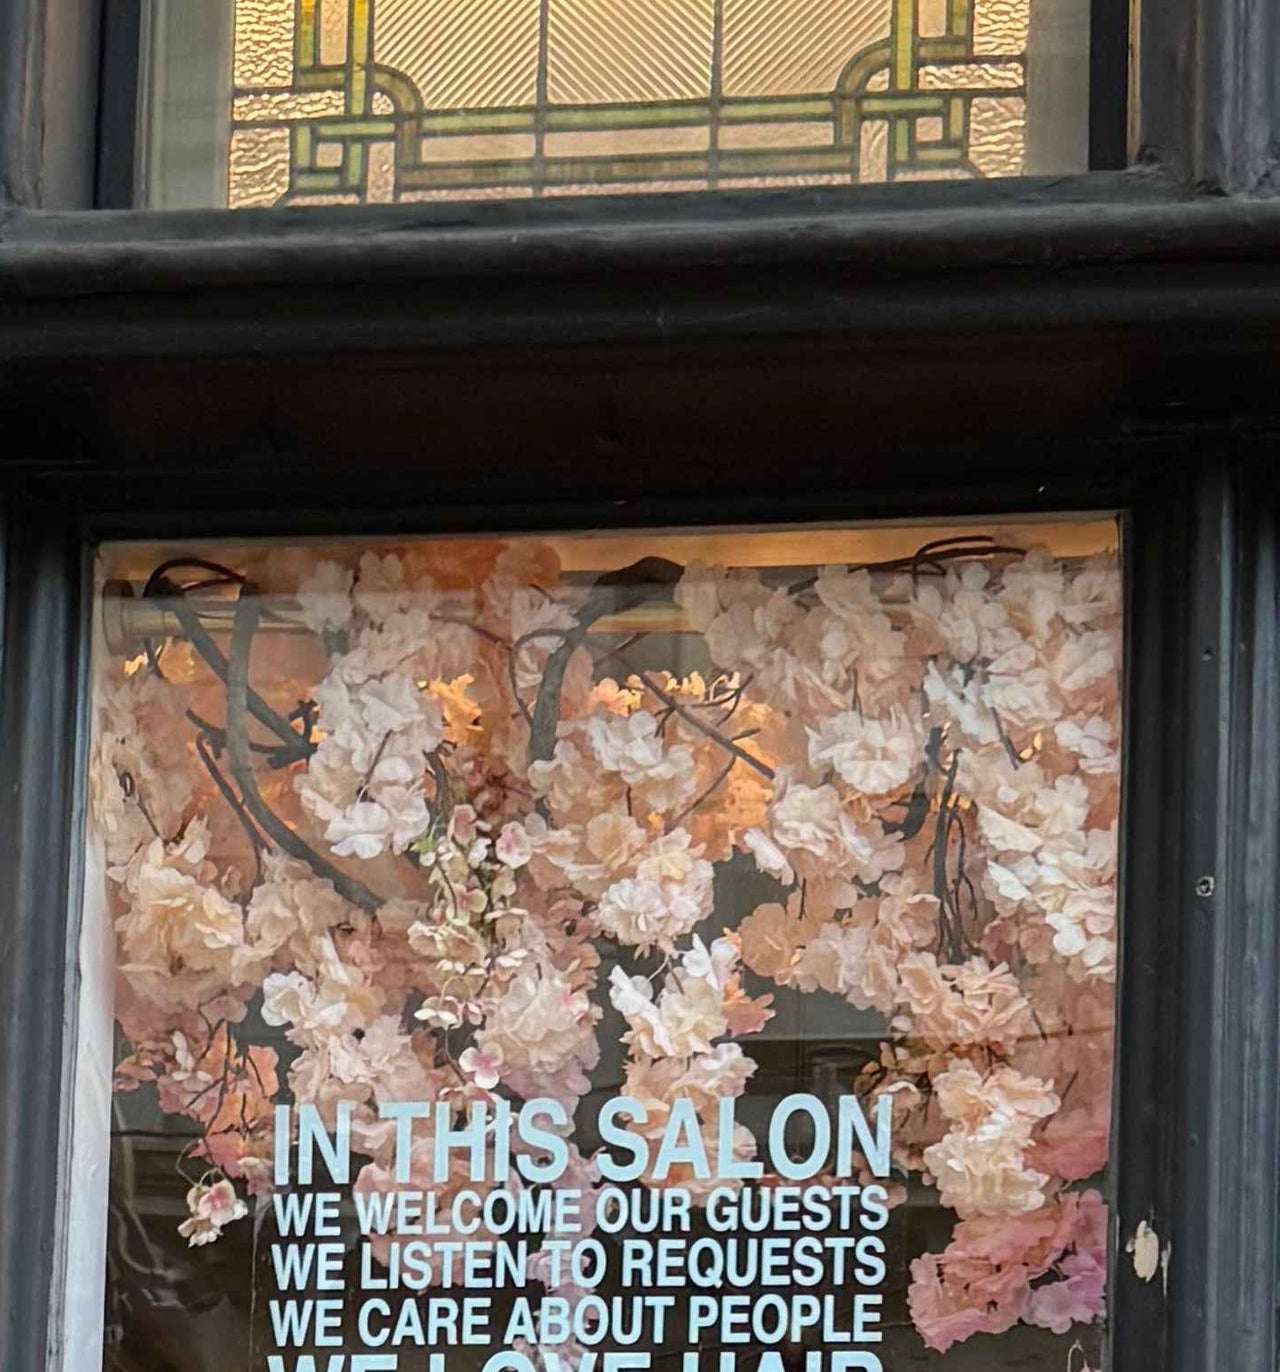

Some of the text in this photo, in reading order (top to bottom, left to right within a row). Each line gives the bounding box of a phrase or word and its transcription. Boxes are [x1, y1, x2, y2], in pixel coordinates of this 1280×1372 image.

[275, 1094, 890, 1185] IN THIS SALON
[272, 1186, 888, 1236] WE WELCOME OUR GUESTS
[270, 1236, 885, 1290] WE LISTEN TO REQUESTS
[268, 1294, 879, 1347] WE CARE ABOUT PEOPLE
